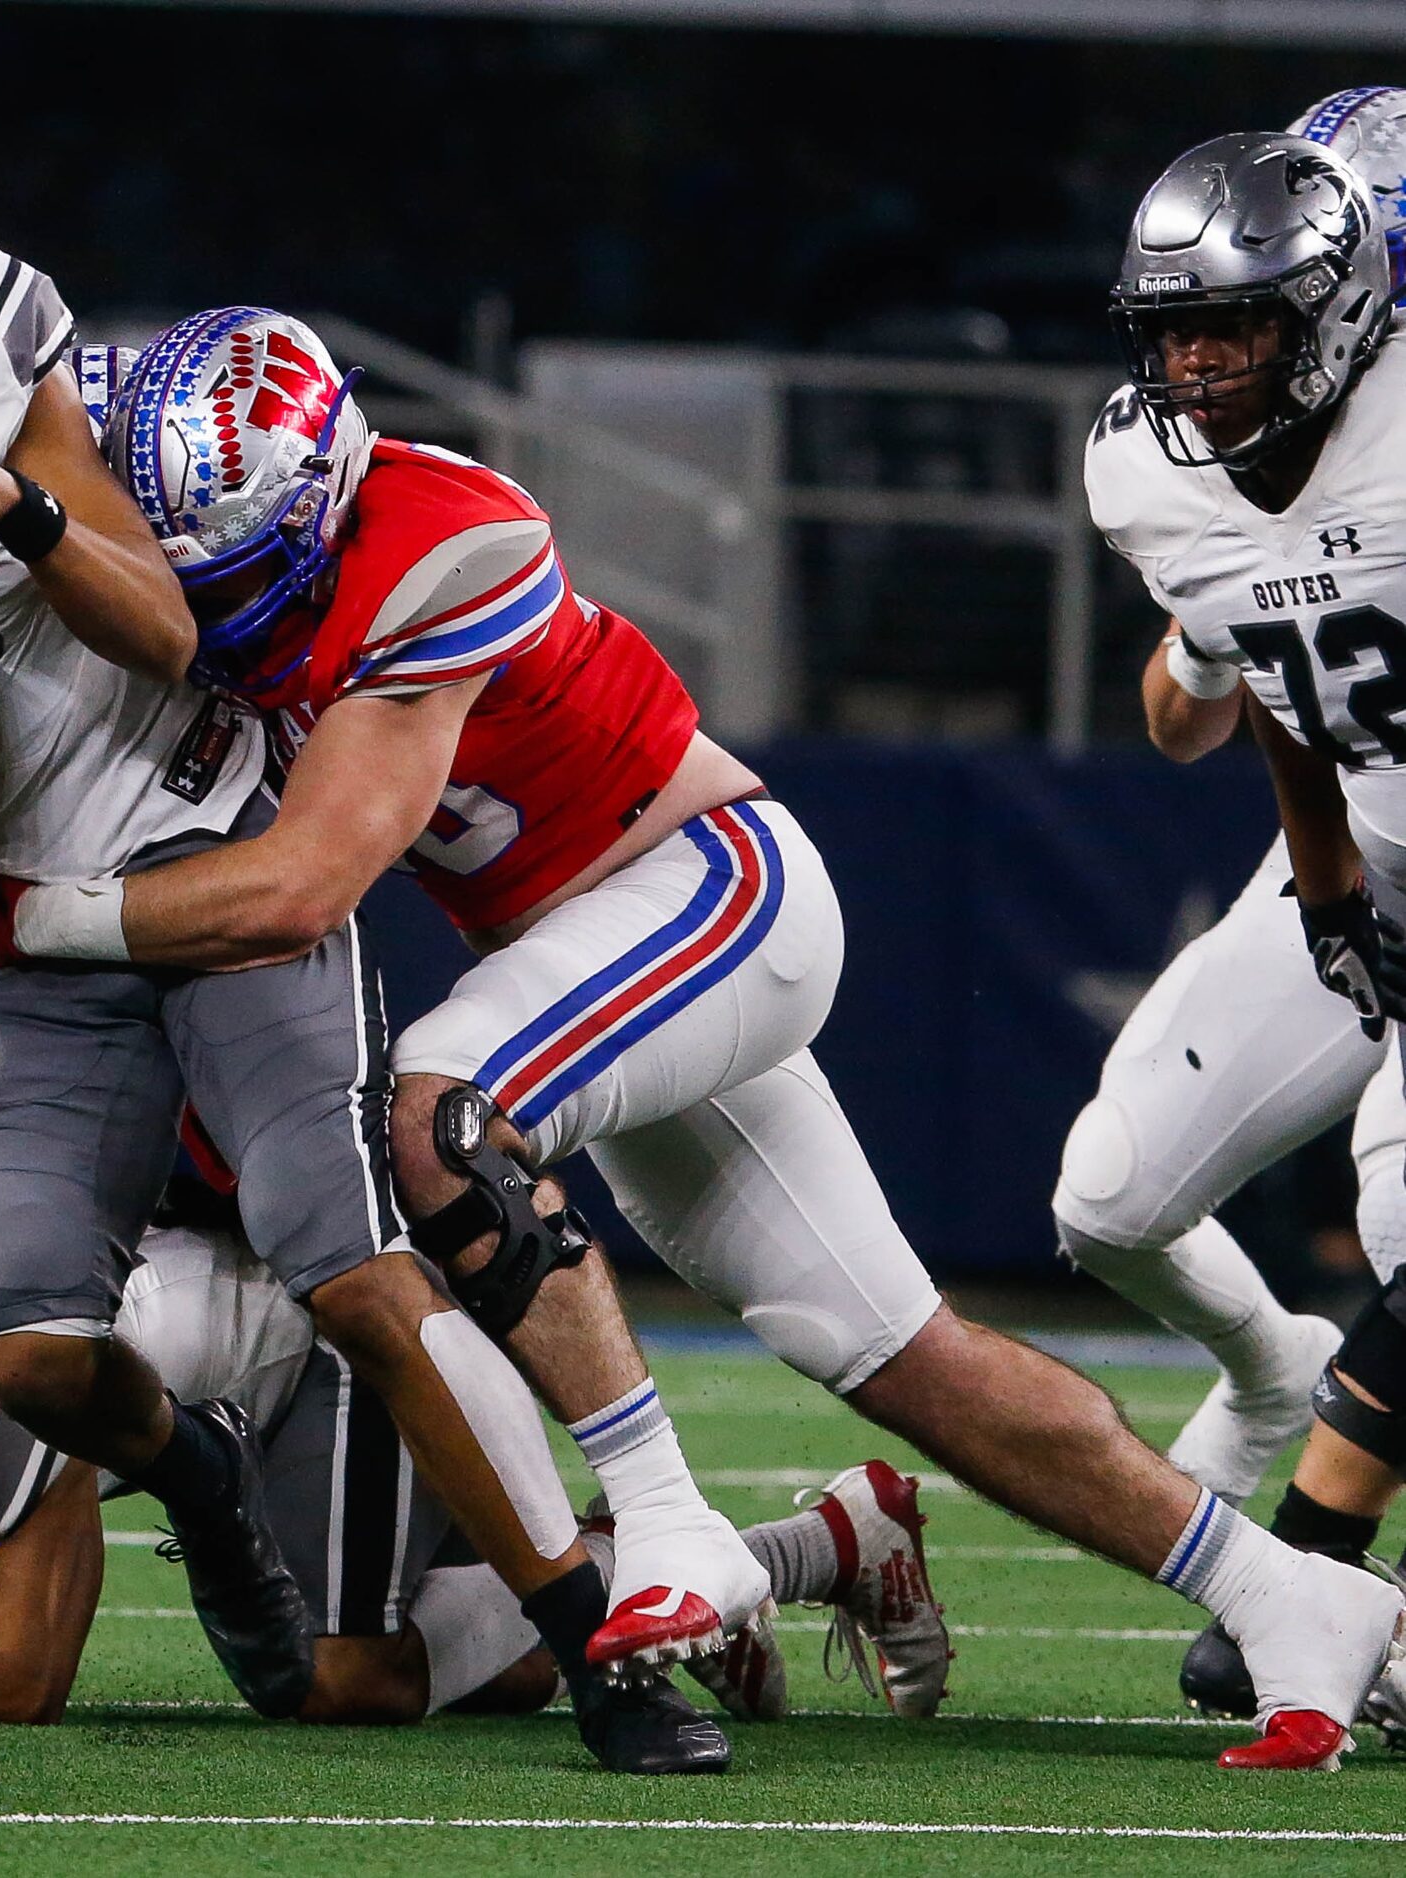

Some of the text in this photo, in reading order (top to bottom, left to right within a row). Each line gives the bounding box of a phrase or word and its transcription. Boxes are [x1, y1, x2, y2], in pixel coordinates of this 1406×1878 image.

[1137, 276, 1191, 293] Riddell
[1251, 572, 1343, 611] GUYER
[1227, 603, 1406, 768] 72
